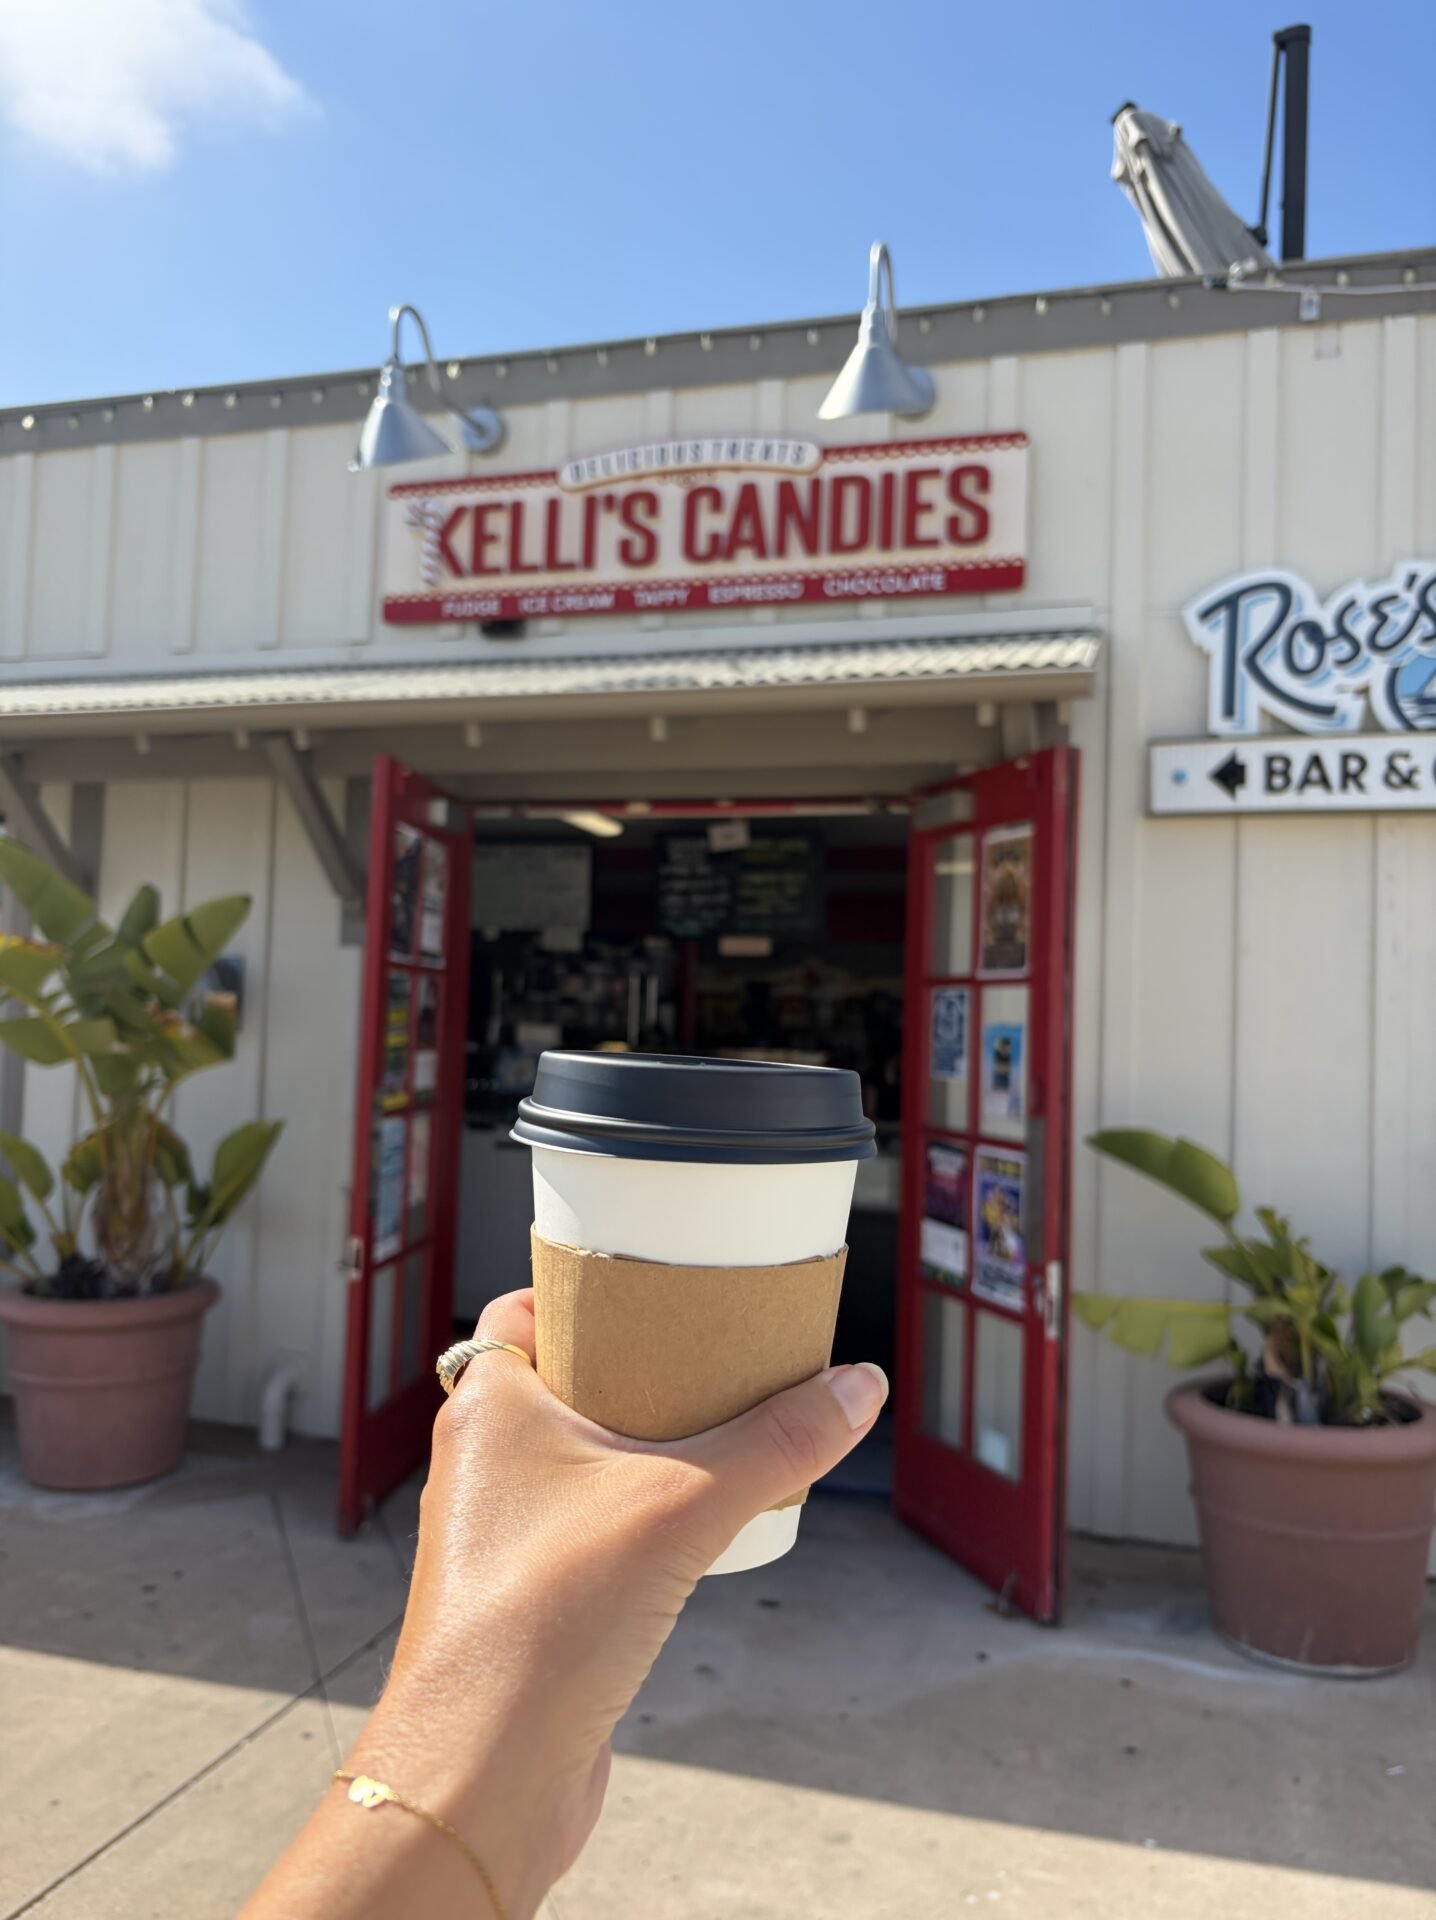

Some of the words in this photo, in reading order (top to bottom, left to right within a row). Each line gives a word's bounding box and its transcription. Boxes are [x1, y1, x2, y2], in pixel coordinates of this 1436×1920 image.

[418, 490, 657, 580] KELLI'S
[683, 465, 991, 566] CANDIES
[442, 599, 500, 616] FUDGE
[520, 596, 548, 613] ICE
[552, 592, 616, 611] CREAM
[633, 588, 690, 607] TAFFY
[708, 581, 804, 604] ESPRESSO
[823, 572, 946, 597] CHOCOLATE
[1263, 754, 1367, 794] BAR
[1383, 750, 1421, 790] &
